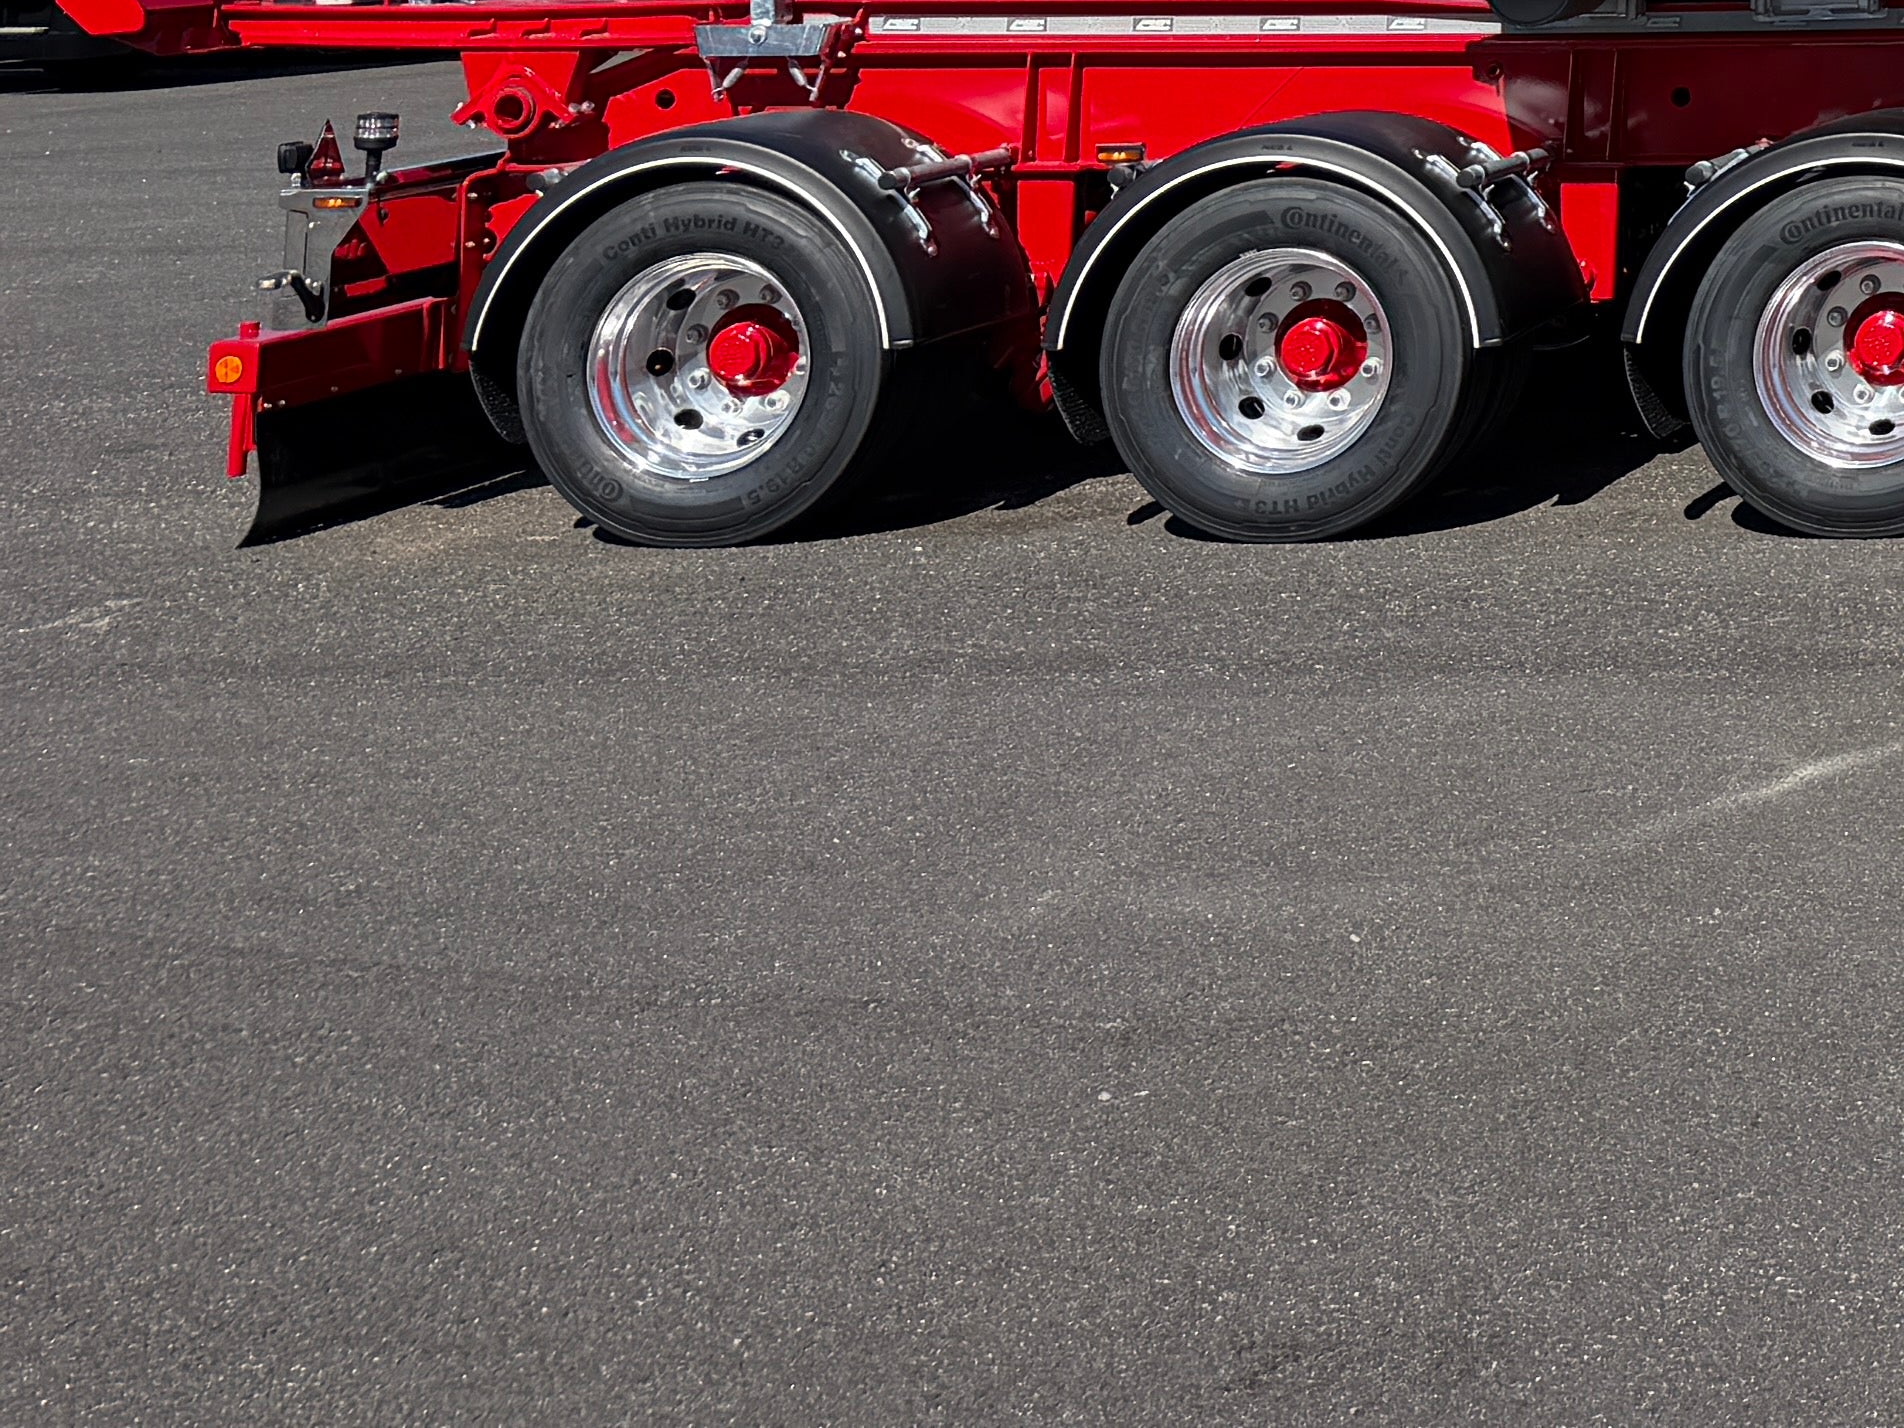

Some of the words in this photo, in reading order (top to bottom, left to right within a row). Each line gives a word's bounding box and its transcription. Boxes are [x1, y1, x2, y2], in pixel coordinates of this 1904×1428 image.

[602, 222, 657, 261] Conti
[663, 214, 737, 234] Hybrid
[1281, 207, 1398, 269] Continental
[1780, 201, 1904, 243] Continental
[1305, 464, 1377, 510] Hybrid
